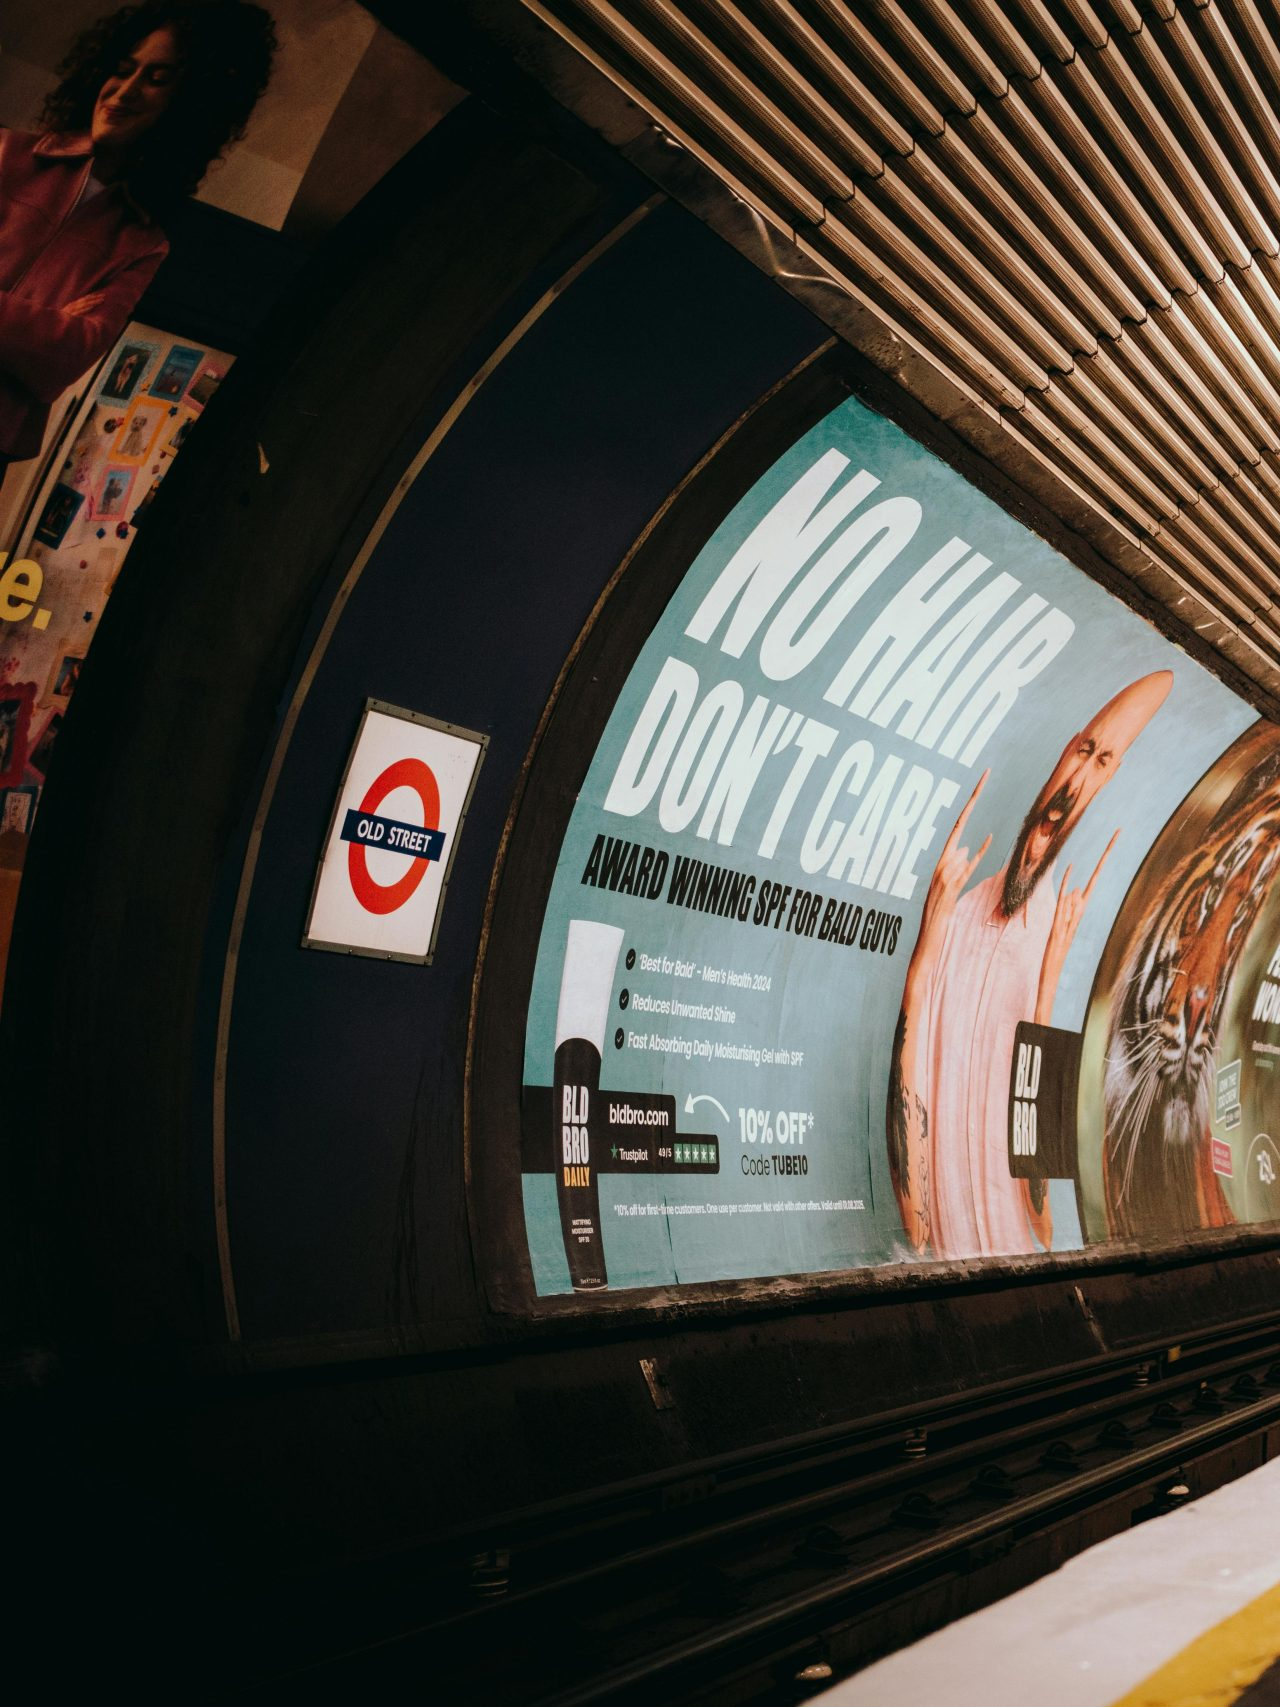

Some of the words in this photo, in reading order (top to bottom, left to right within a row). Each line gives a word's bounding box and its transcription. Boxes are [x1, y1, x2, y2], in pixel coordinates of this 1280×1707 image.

[0, 552, 52, 630] e.
[684, 447, 923, 682] NO
[822, 536, 1076, 769] HAIR
[603, 656, 839, 859] DON'T
[799, 740, 960, 901] CARE
[357, 819, 385, 841] OLD
[387, 826, 433, 853] STREET
[580, 834, 670, 900] AWARD
[667, 855, 756, 922] WINNING
[753, 879, 793, 930] SPF
[786, 890, 823, 938] FOR
[817, 897, 863, 946] BALD
[859, 908, 903, 957] GUYS
[662, 958, 674, 975] for
[727, 971, 752, 988] Health
[752, 975, 772, 992] 2024
[632, 993, 671, 1013] Reduces
[671, 1000, 714, 1020] Unwanted
[714, 1006, 736, 1024] Shine
[627, 1031, 648, 1049] Fast
[649, 1034, 693, 1060] Absorbing
[693, 1039, 715, 1062] Daily
[714, 1042, 761, 1067] Moisturising
[761, 1047, 774, 1063] Gel
[774, 1049, 790, 1065] with
[790, 1051, 805, 1067] SPF
[1014, 1043, 1042, 1100] BLD
[562, 1085, 590, 1124] BLD
[609, 1103, 669, 1126] bldbro.com
[562, 1125, 590, 1164] BRO
[739, 1108, 774, 1145] 10%
[1013, 1101, 1037, 1156] BRO
[619, 1147, 649, 1163] Trustpilot
[741, 1154, 771, 1176] Code
[771, 1154, 808, 1176] TUBE10
[564, 1166, 591, 1188] DAILY
